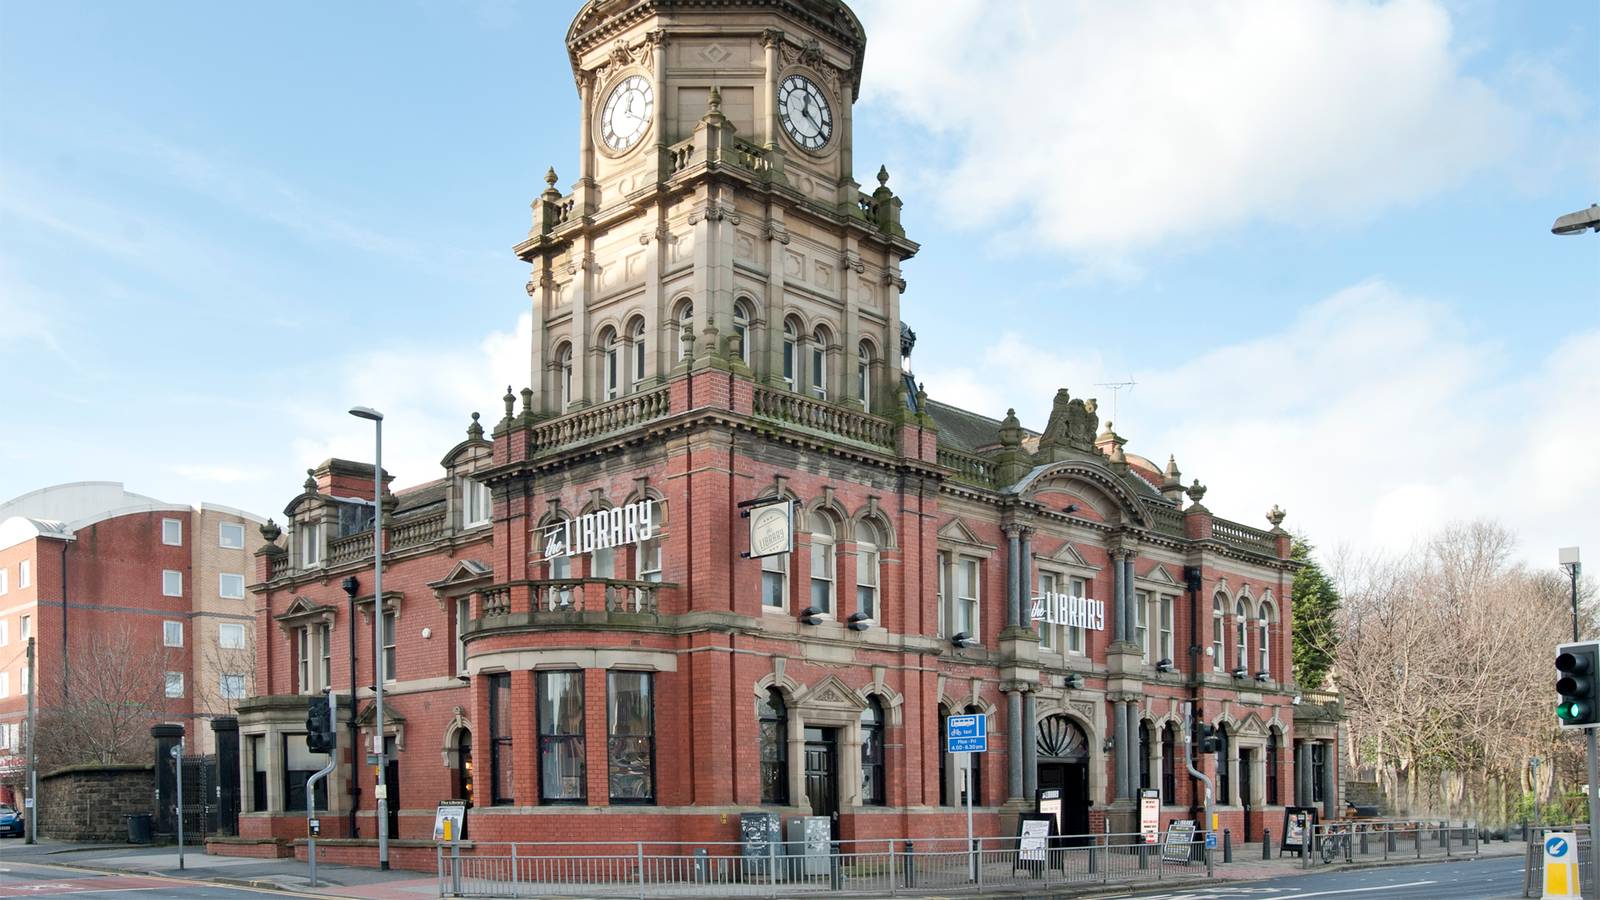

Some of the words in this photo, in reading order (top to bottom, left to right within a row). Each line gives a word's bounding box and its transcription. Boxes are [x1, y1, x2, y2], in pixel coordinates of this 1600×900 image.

[545, 529, 563, 559] the
[565, 499, 652, 556] LIBRARY
[1031, 598, 1046, 618] the
[1047, 591, 1104, 631] LIBRARY
